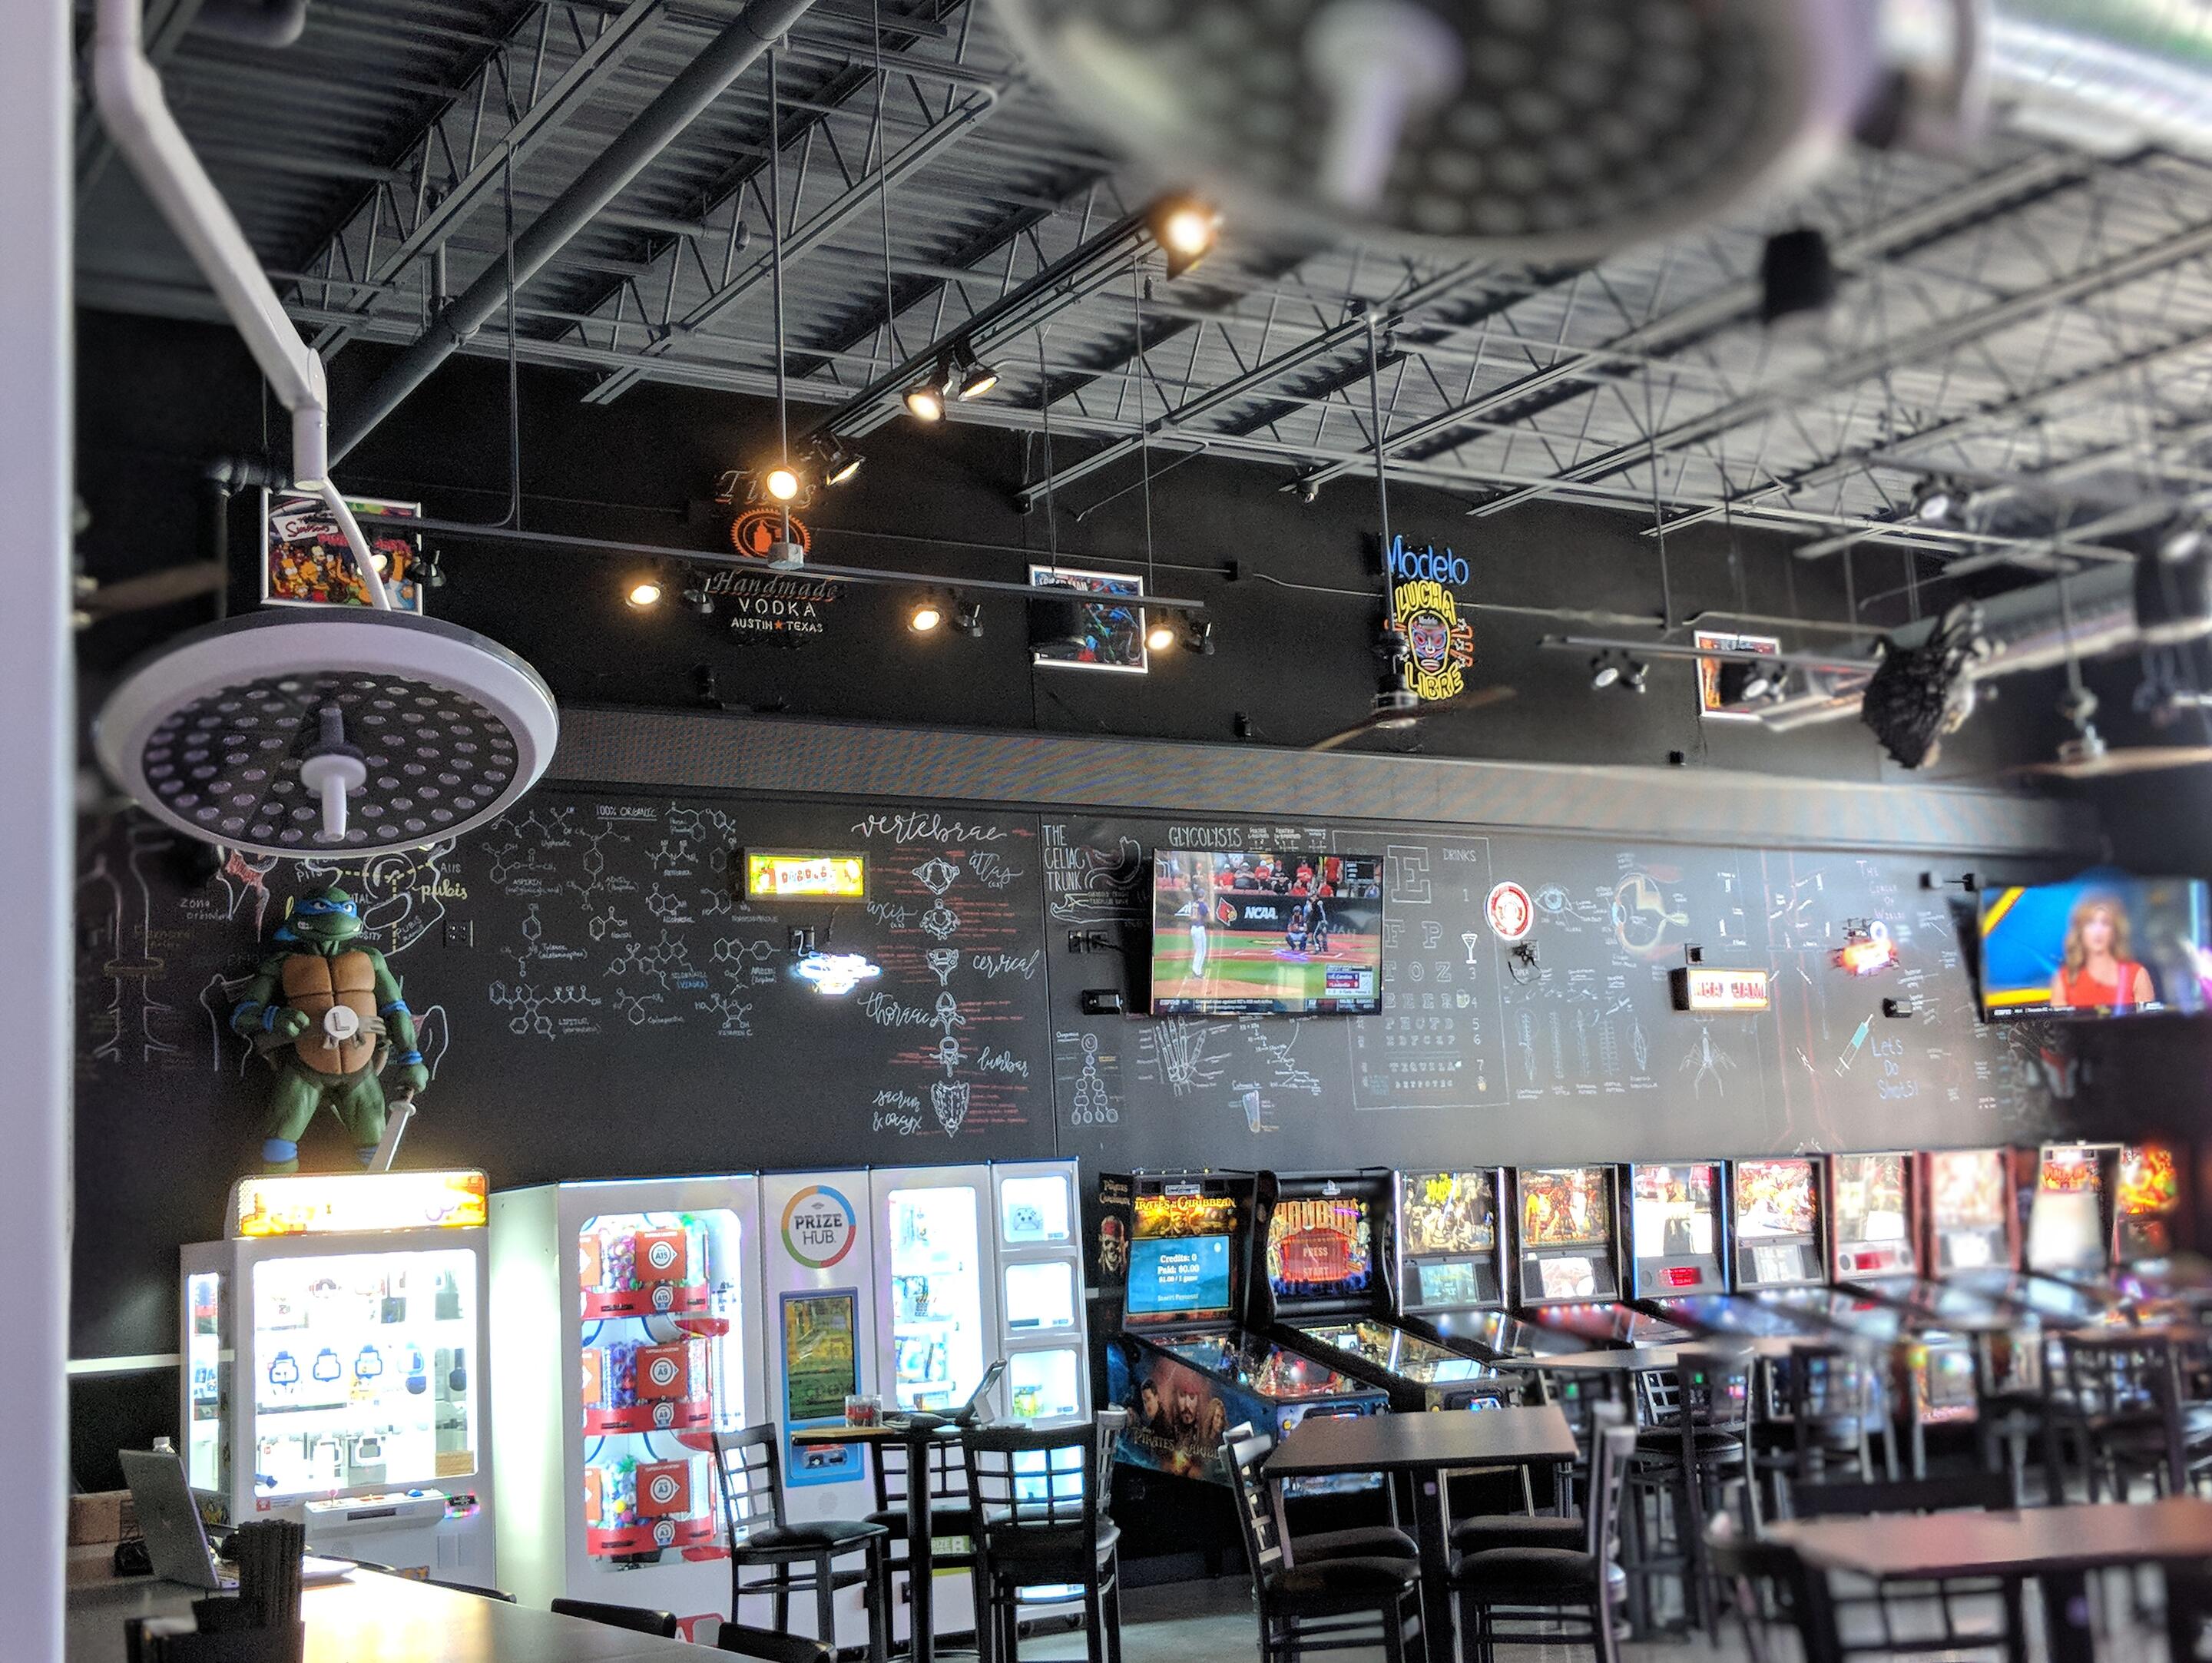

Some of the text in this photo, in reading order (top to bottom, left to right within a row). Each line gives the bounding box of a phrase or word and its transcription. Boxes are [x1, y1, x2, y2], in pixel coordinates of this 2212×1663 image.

[1386, 535, 1470, 585] Modelo
[711, 568, 839, 603] Handmade
[738, 597, 816, 618] VODKA
[1395, 580, 1457, 625] LUCHA
[730, 617, 824, 633] AUSTIN TEXAS
[1404, 661, 1464, 701] LIBRE
[850, 811, 1008, 844] vertebrae
[1043, 824, 1068, 846] THE
[1168, 826, 1243, 847] GLYCOLYSIS
[1044, 846, 1086, 870] CELIAC
[1443, 847, 1476, 863] DRINKS
[969, 850, 1025, 884] atlas
[1387, 844, 1432, 904] E
[422, 879, 469, 903] pubis
[1046, 871, 1083, 893] TRUNK
[1462, 888, 1470, 903] 1
[866, 900, 919, 926] axis
[1244, 906, 1278, 919] NCAA
[972, 949, 1040, 980] cervical
[1730, 982, 1765, 999] JAM
[856, 992, 931, 1026] thoracic
[331, 1011, 351, 1032] L
[1472, 1017, 1480, 1031] 5
[1473, 1033, 1482, 1045] 6
[976, 1045, 1029, 1078] lumbar
[1475, 1058, 1485, 1072] 7
[872, 1090, 921, 1113] sacrum
[1177, 1195, 1237, 1211] CARIBBEAN
[794, 1214, 843, 1230] PRIZE
[803, 1230, 835, 1245] HUB
[1160, 1253, 1197, 1264] Credits: 0
[1303, 1247, 1329, 1257] PRESS
[1157, 1265, 1177, 1275] Paid:
[1303, 1267, 1330, 1277] START
[657, 1367, 668, 1376] A9
[658, 1485, 669, 1493] A3
